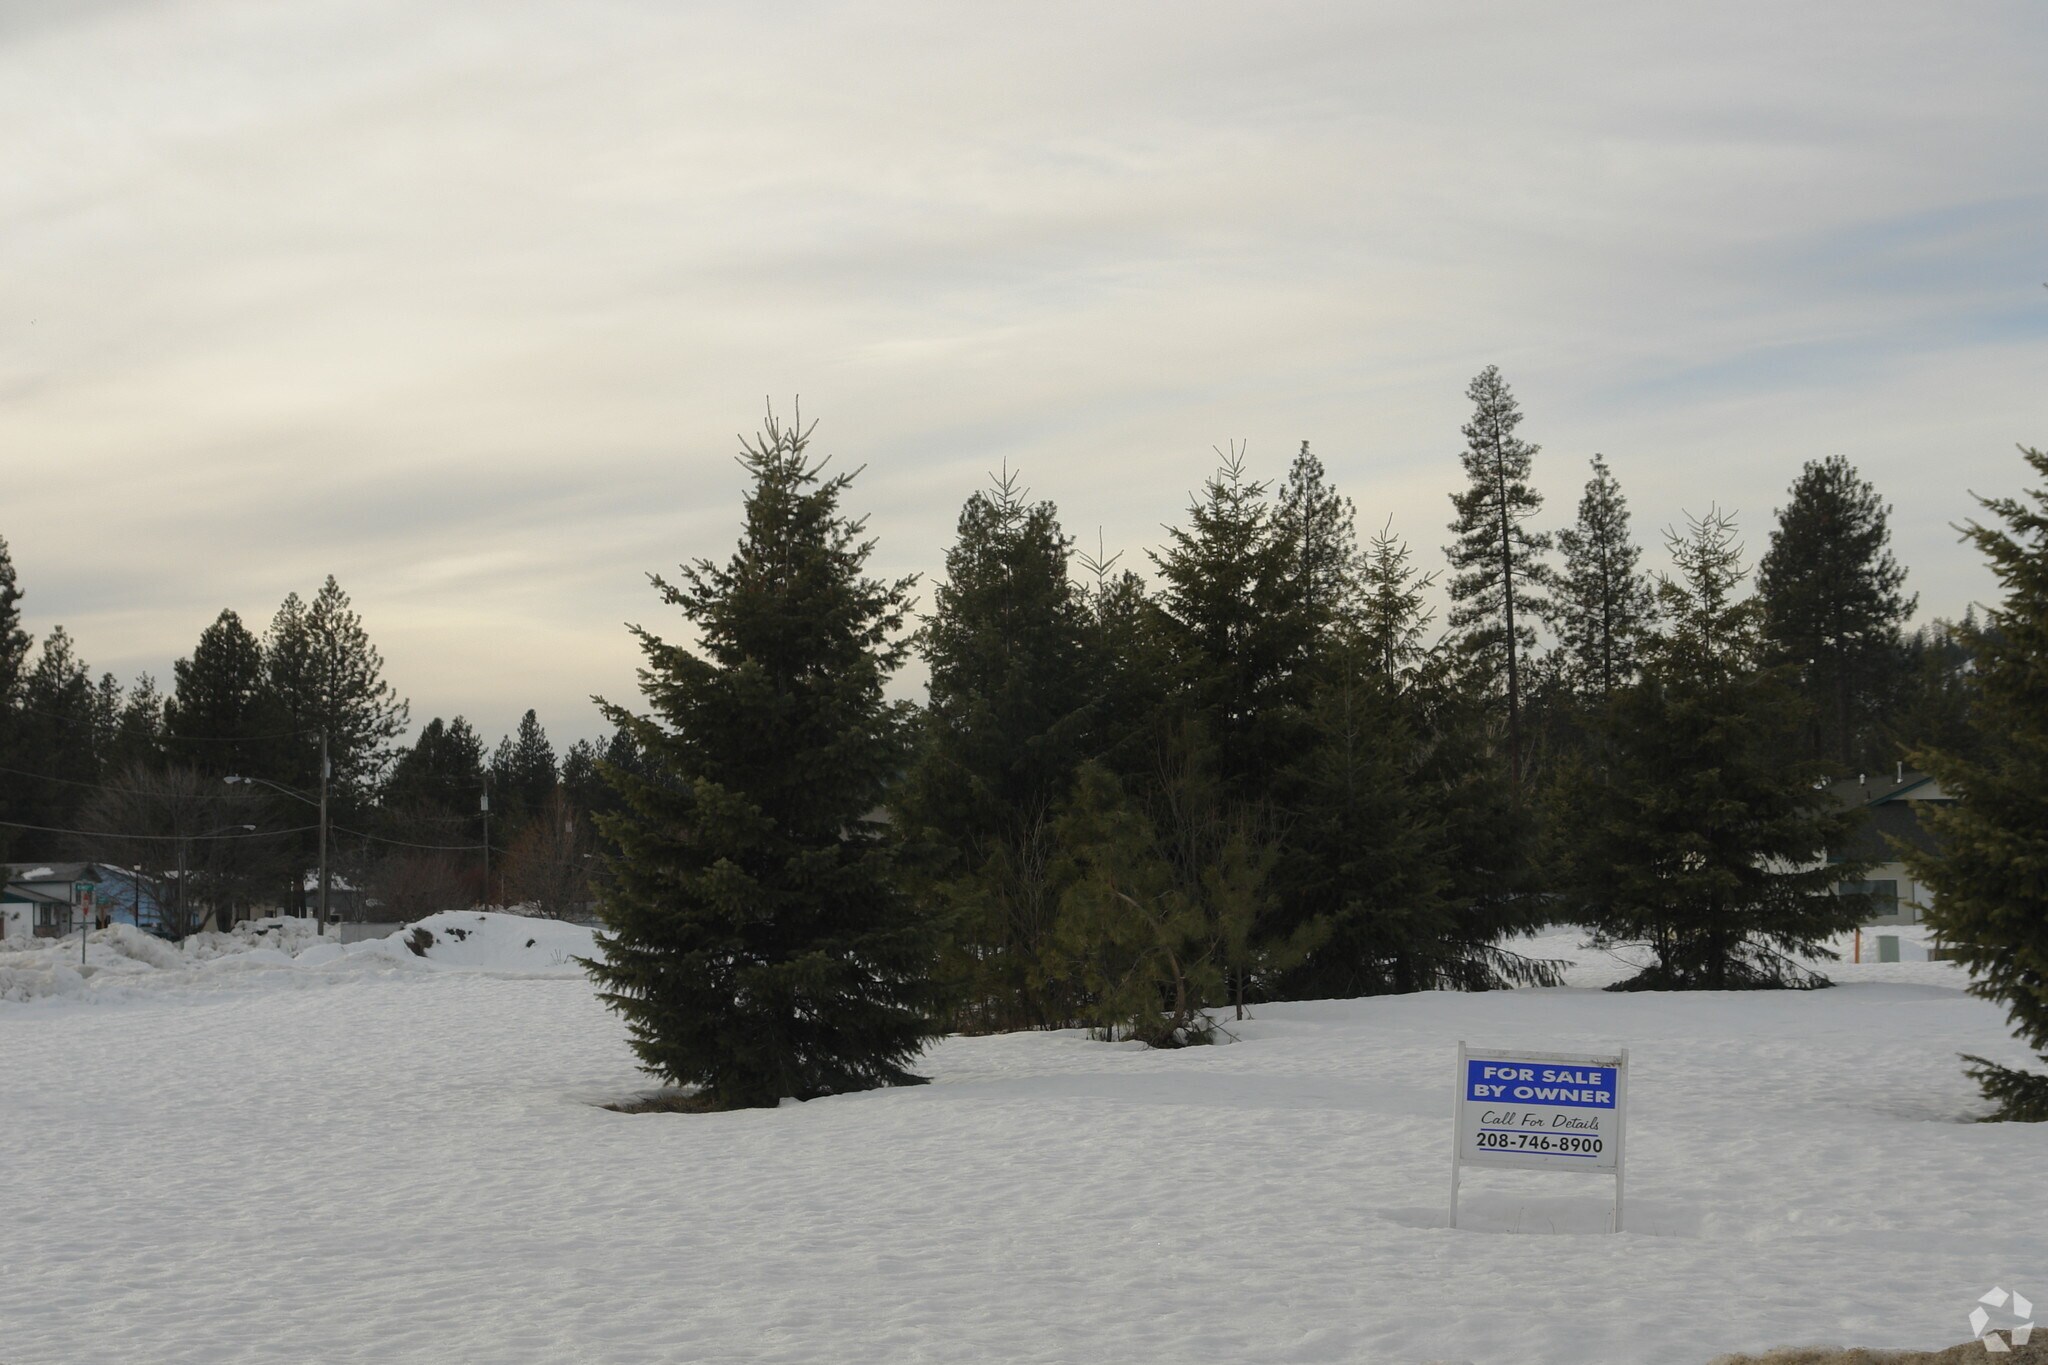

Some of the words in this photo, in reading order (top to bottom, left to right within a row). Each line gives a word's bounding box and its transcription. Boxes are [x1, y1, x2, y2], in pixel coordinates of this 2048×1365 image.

[1484, 1067, 1534, 1082] FOR
[1542, 1070, 1601, 1085] SALE
[1474, 1084, 1507, 1097] BY
[1513, 1086, 1611, 1104] OWNER
[1481, 1110, 1515, 1126] Call
[1521, 1113, 1545, 1127] For
[1552, 1114, 1600, 1131] Details
[1476, 1133, 1603, 1153] 208-746-8900
